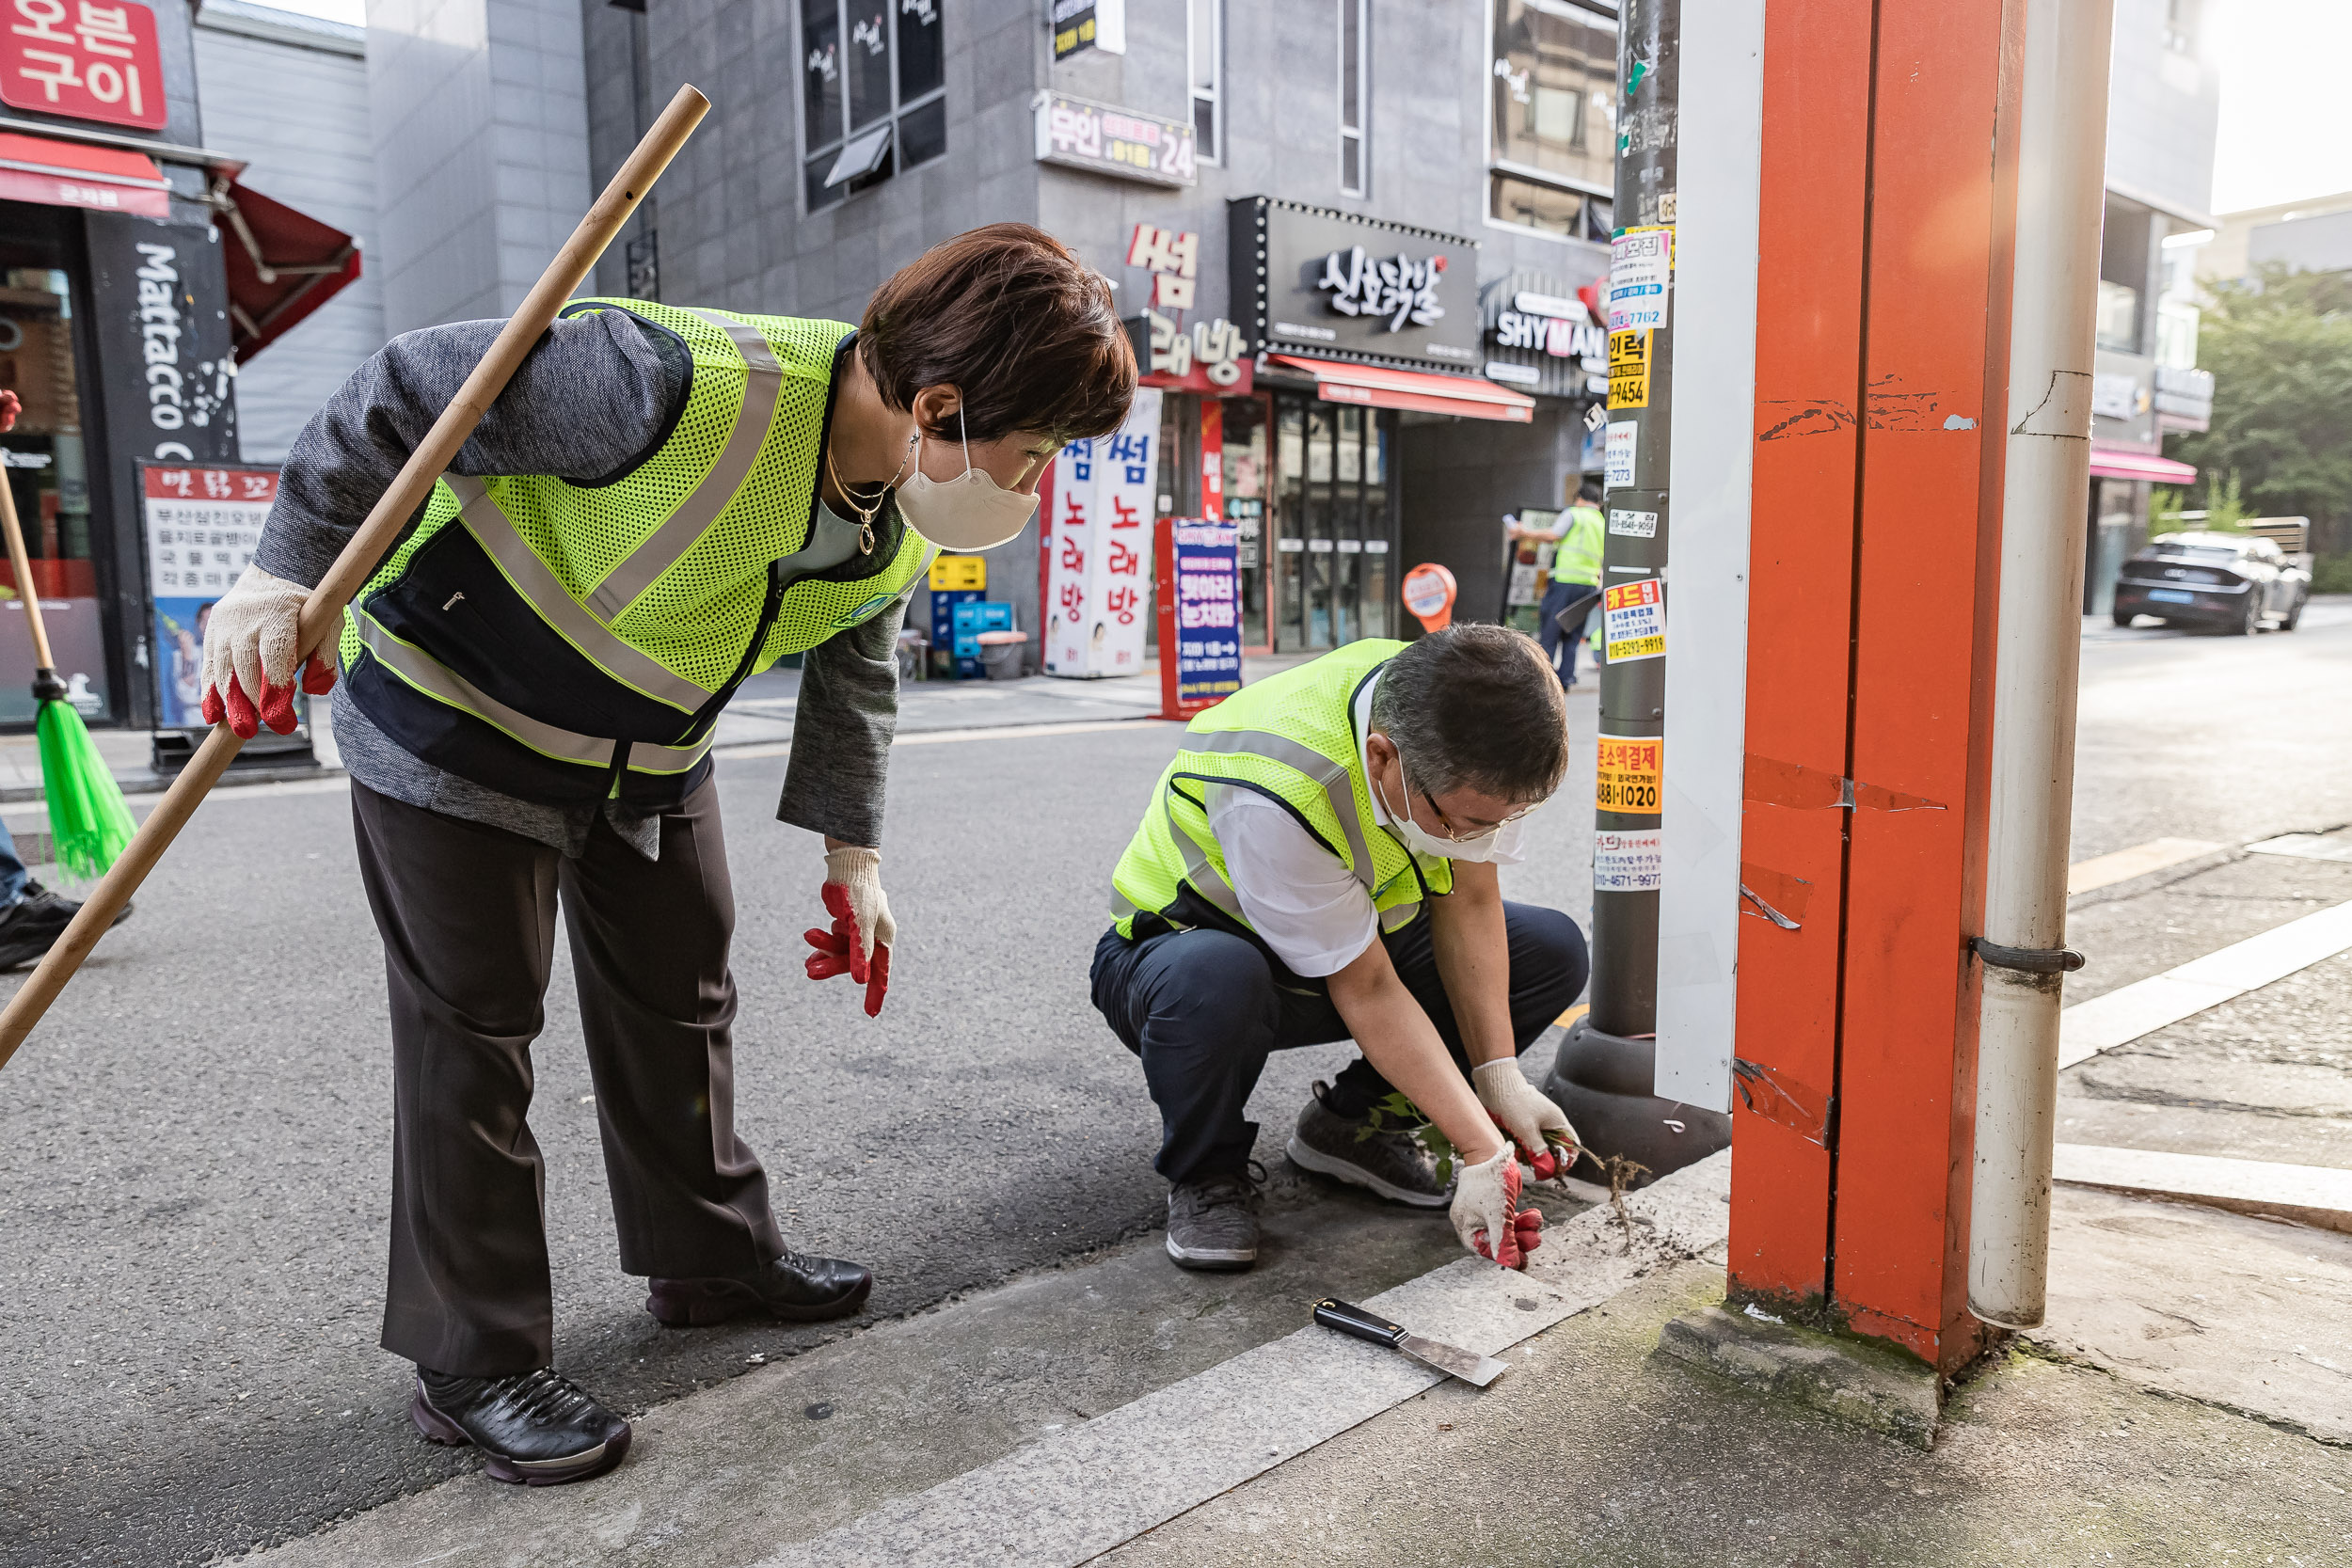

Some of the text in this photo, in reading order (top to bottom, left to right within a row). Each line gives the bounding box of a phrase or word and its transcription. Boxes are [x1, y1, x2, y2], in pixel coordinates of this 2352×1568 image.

[11, 0, 137, 59] 오븐
[19, 48, 145, 117] 구이
[1051, 105, 1102, 159] 무인
[1160, 132, 1195, 179] 24
[1126, 223, 1200, 309] 썸
[135, 242, 184, 431] Mattacco
[1149, 309, 1248, 387] 래방
[1496, 311, 1605, 358] SHYMAN
[1610, 334, 1645, 363] 인력
[1108, 433, 1150, 484] 썸
[1060, 491, 1085, 624] 노래방
[1107, 495, 1140, 626] 노래방
[1607, 585, 1641, 610] 카드
